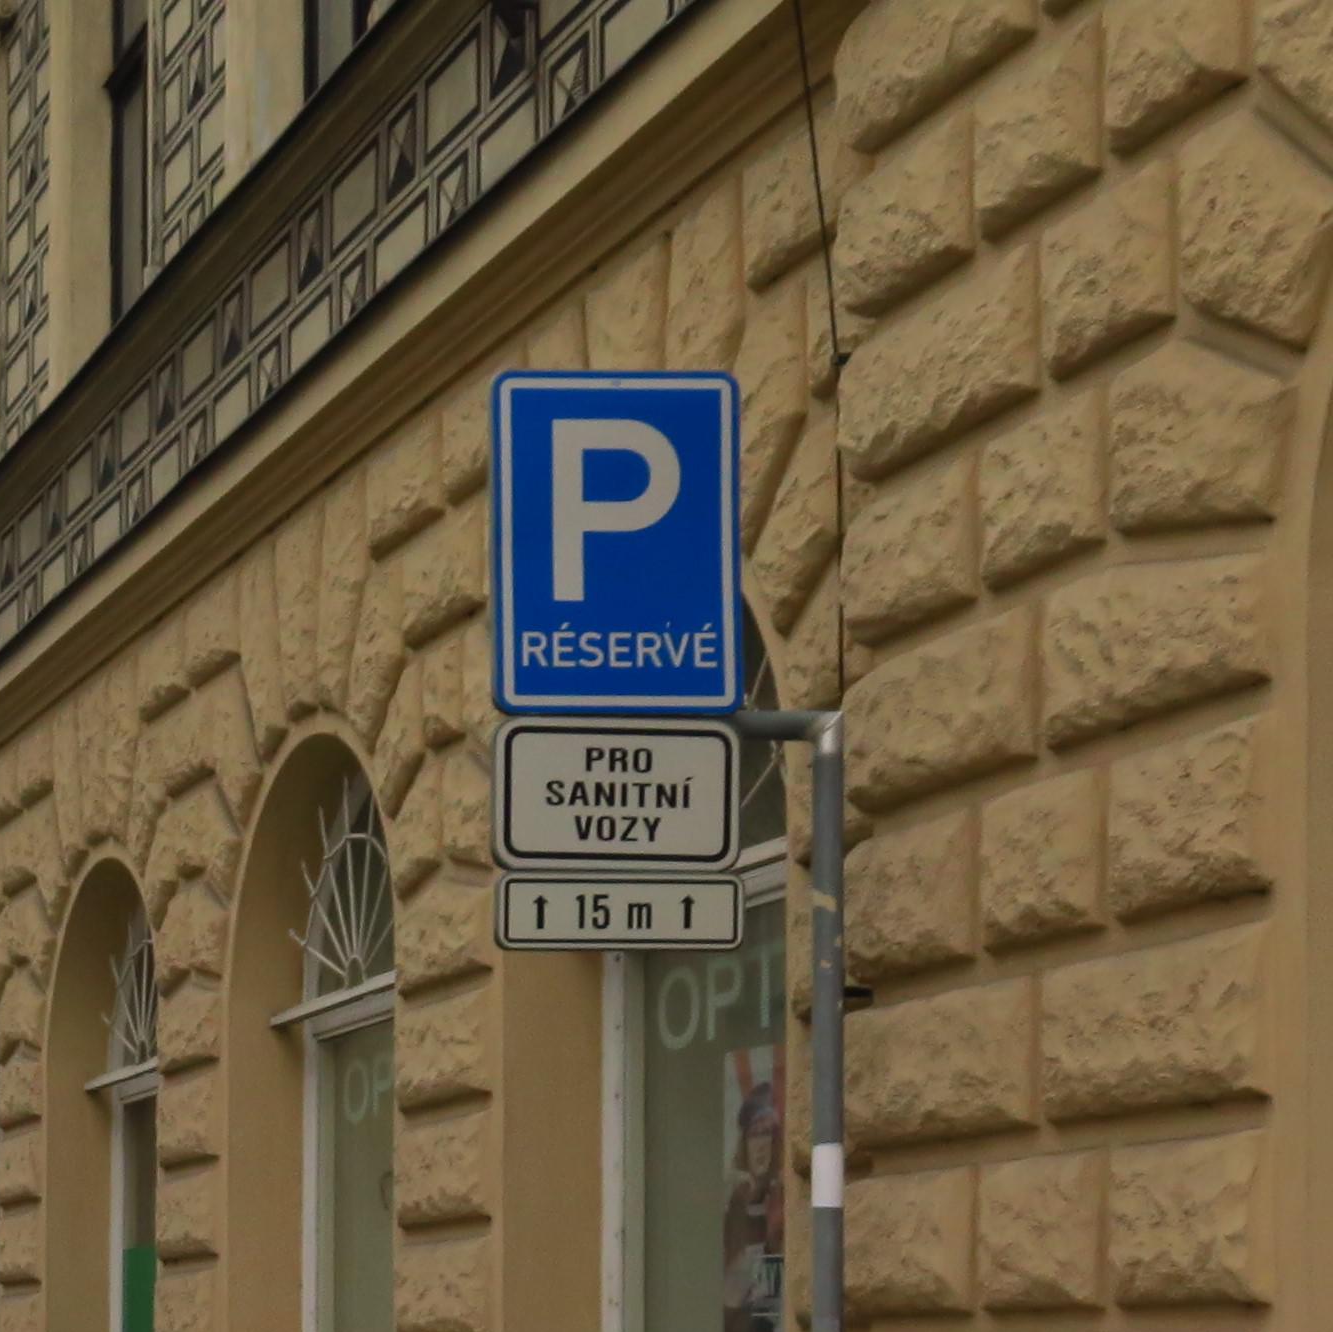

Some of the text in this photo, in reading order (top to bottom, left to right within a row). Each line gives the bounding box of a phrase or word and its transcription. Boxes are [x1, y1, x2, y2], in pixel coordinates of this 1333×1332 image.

[551, 418, 681, 602] P
[520, 621, 718, 668] RÉSERVÉ
[585, 746, 653, 774] PRO
[545, 777, 694, 809] SANITNÍ
[574, 815, 662, 843] VOZY
[575, 893, 653, 931] 15 m
